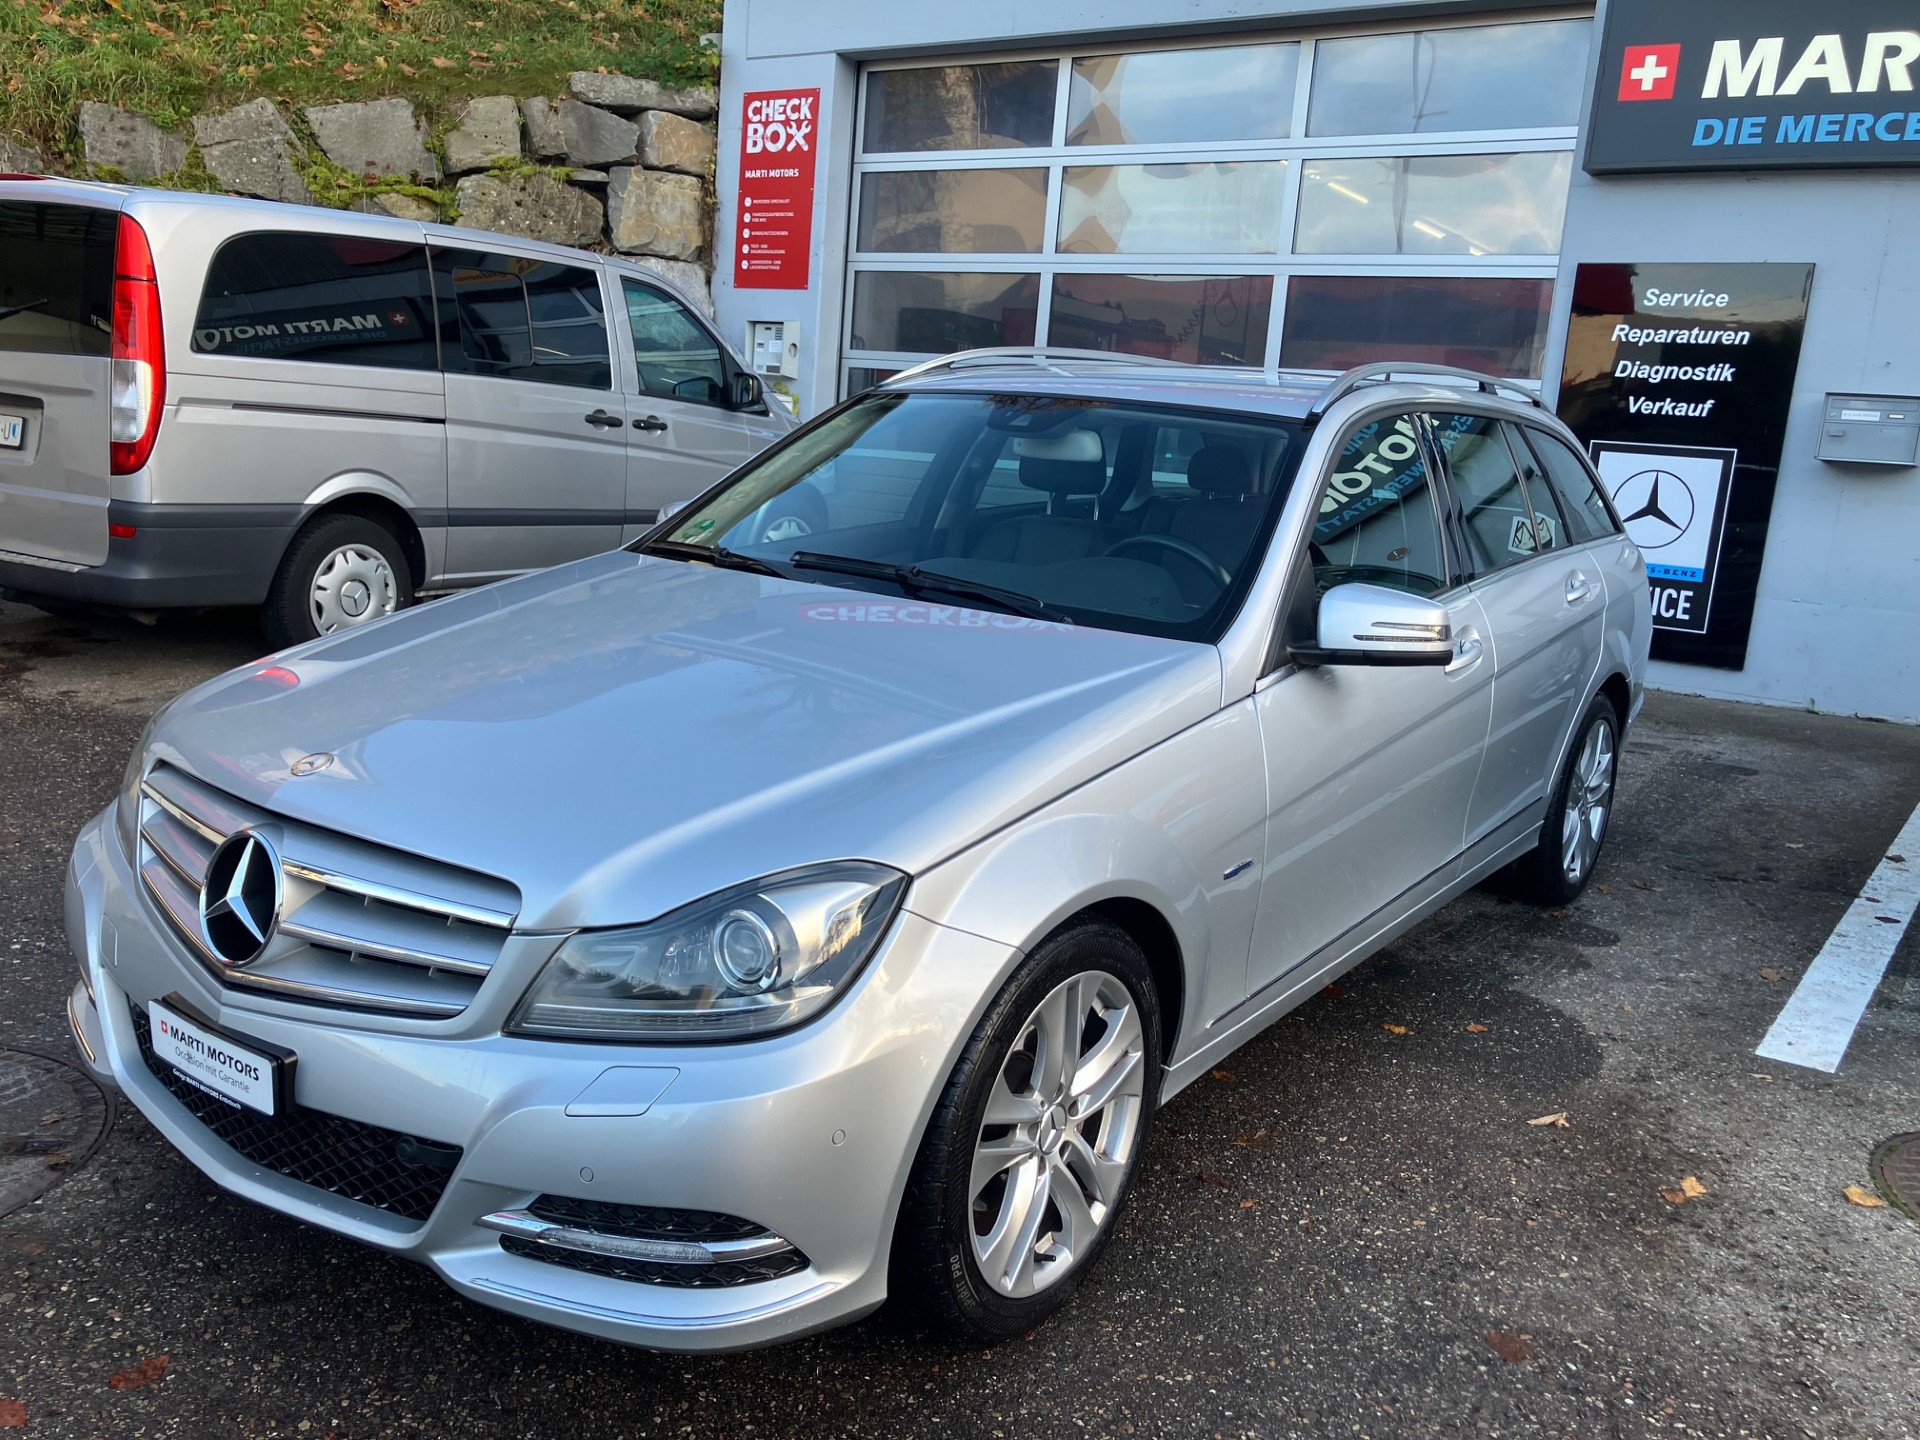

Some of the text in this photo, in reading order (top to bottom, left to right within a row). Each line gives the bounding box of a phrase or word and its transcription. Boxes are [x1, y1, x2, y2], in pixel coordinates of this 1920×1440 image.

[1701, 31, 1920, 99] MAR
[747, 97, 814, 122] CHECK
[746, 121, 812, 154] BOX
[1692, 116, 1767, 146] DIE
[745, 168, 799, 179] MARTI MOTORS
[1643, 288, 1729, 307] Service
[1611, 324, 1750, 346] Reparaturen
[1614, 360, 1736, 383] Diagnostik
[1629, 396, 1715, 417] Verkauf
[1646, 566, 1697, 578] S-BENZ
[170, 1025, 260, 1082] MARTI MOTORS
[205, 1062, 218, 1076] mit
[218, 1069, 251, 1094] Garantie
[949, 1254, 976, 1310] SPIRIT PRO
